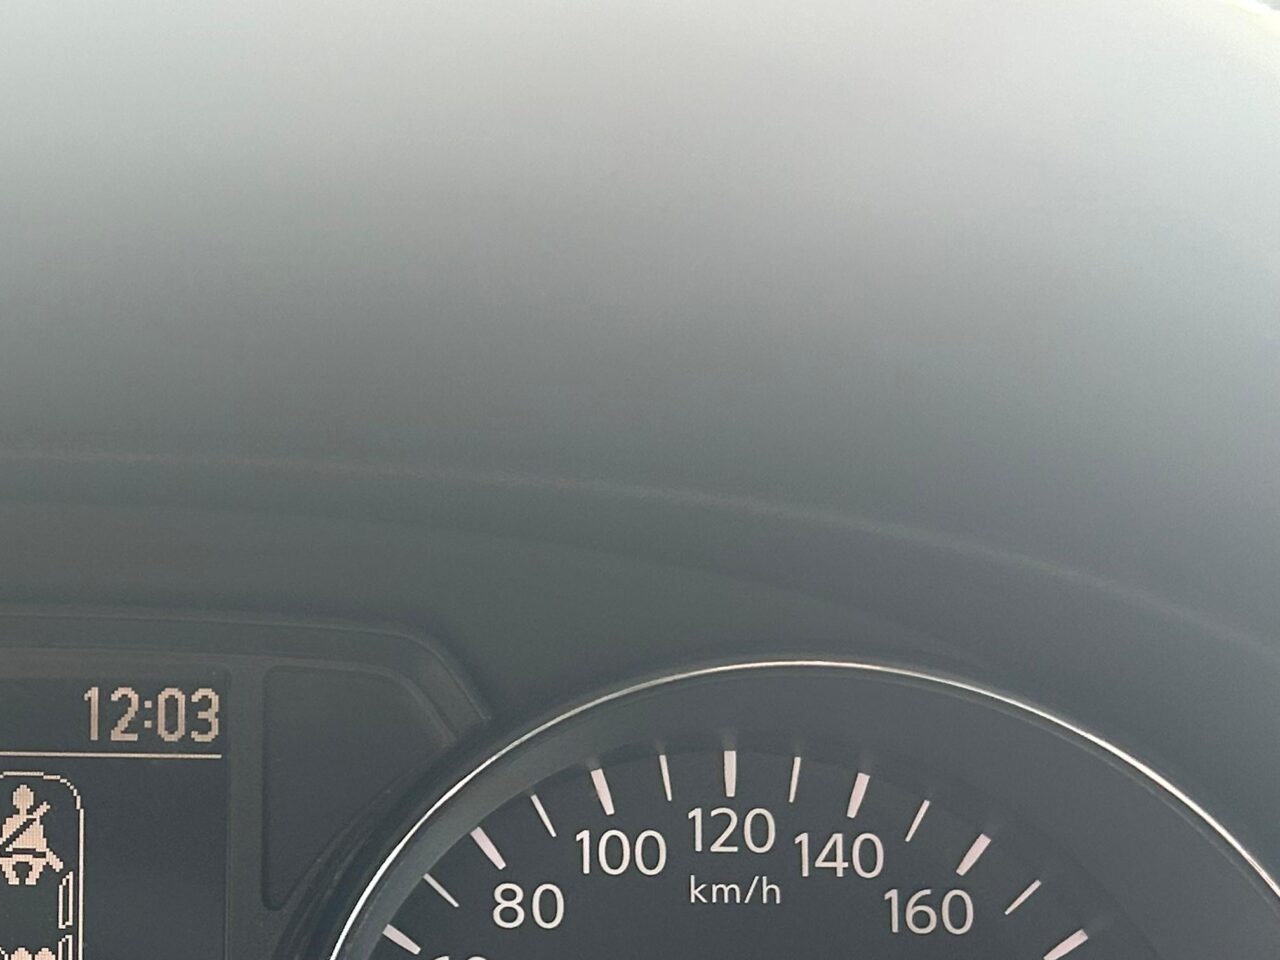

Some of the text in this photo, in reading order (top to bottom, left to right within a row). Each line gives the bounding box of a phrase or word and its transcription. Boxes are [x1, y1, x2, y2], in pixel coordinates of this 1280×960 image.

[83, 686, 220, 743] 12:03
[575, 829, 667, 876] 100
[688, 807, 776, 854] 120
[794, 832, 884, 879] 140
[492, 882, 565, 929] 80
[690, 874, 781, 904] km/h
[884, 888, 974, 935] 160
